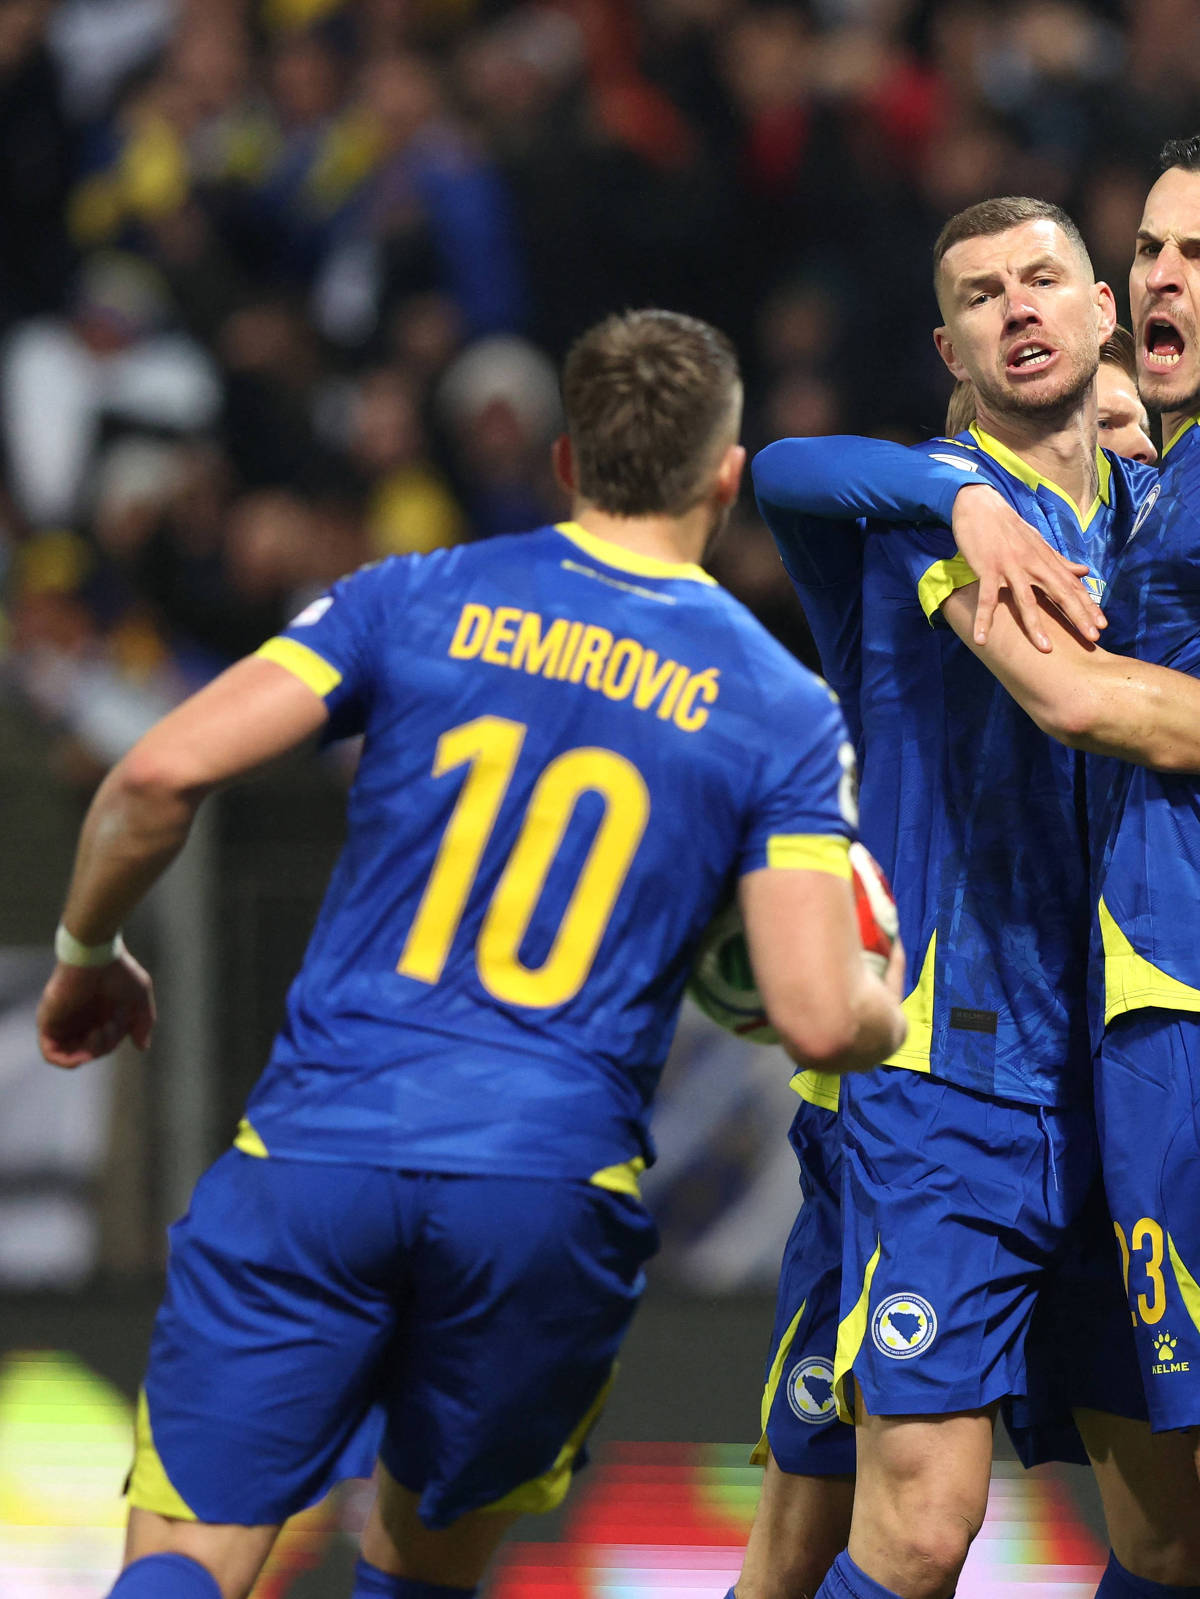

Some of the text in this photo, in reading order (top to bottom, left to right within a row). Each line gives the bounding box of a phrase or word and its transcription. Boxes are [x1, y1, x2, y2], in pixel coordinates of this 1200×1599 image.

[449, 603, 720, 732] DEMIROVIĆ
[396, 715, 651, 1009] 10
[1152, 1361, 1190, 1375] KELME
